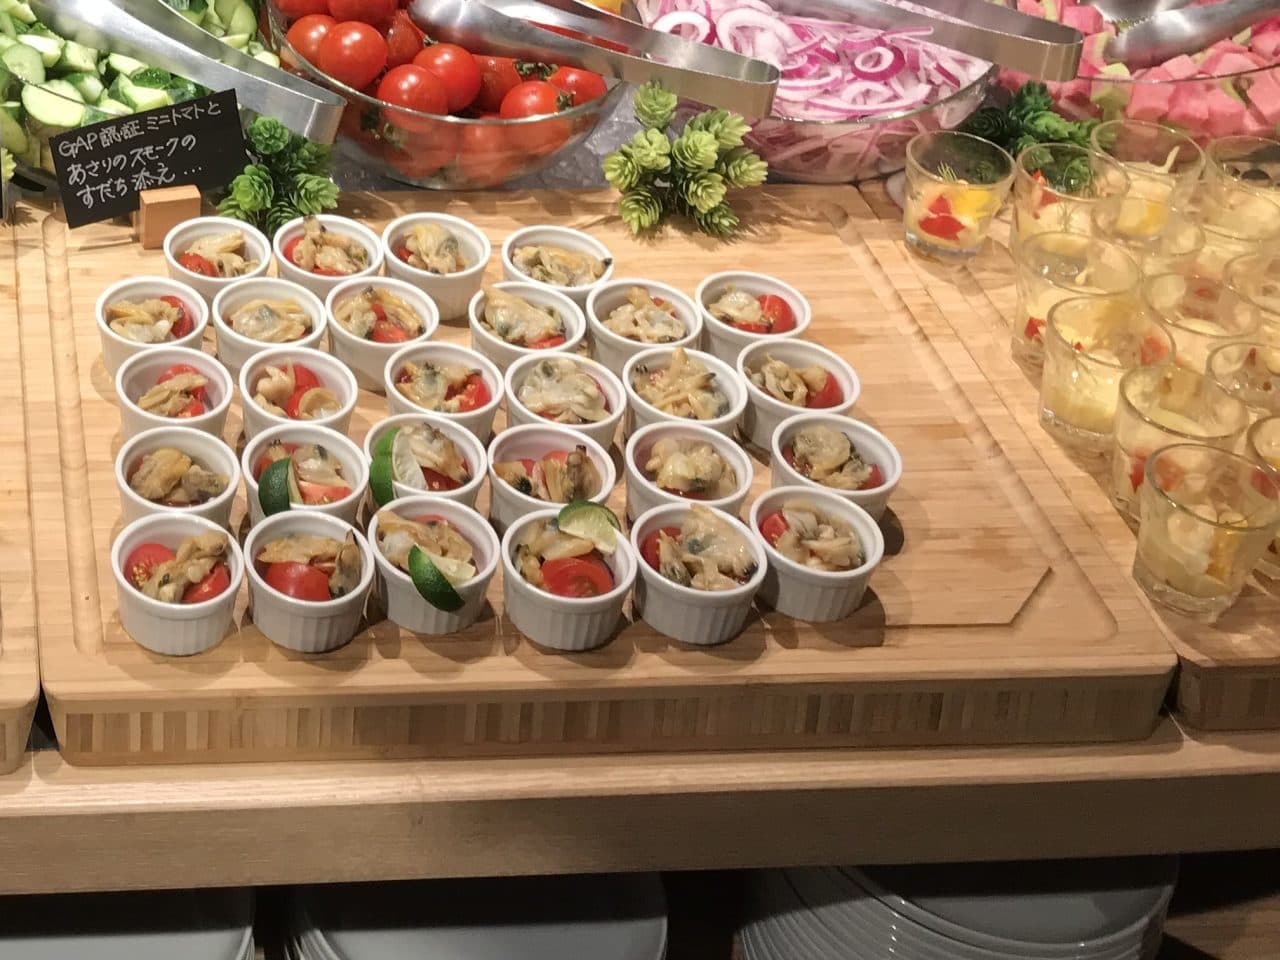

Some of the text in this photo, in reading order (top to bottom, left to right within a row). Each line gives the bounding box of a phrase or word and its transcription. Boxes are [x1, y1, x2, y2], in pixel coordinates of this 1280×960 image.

[66, 134, 197, 186] あさりのスモークの
